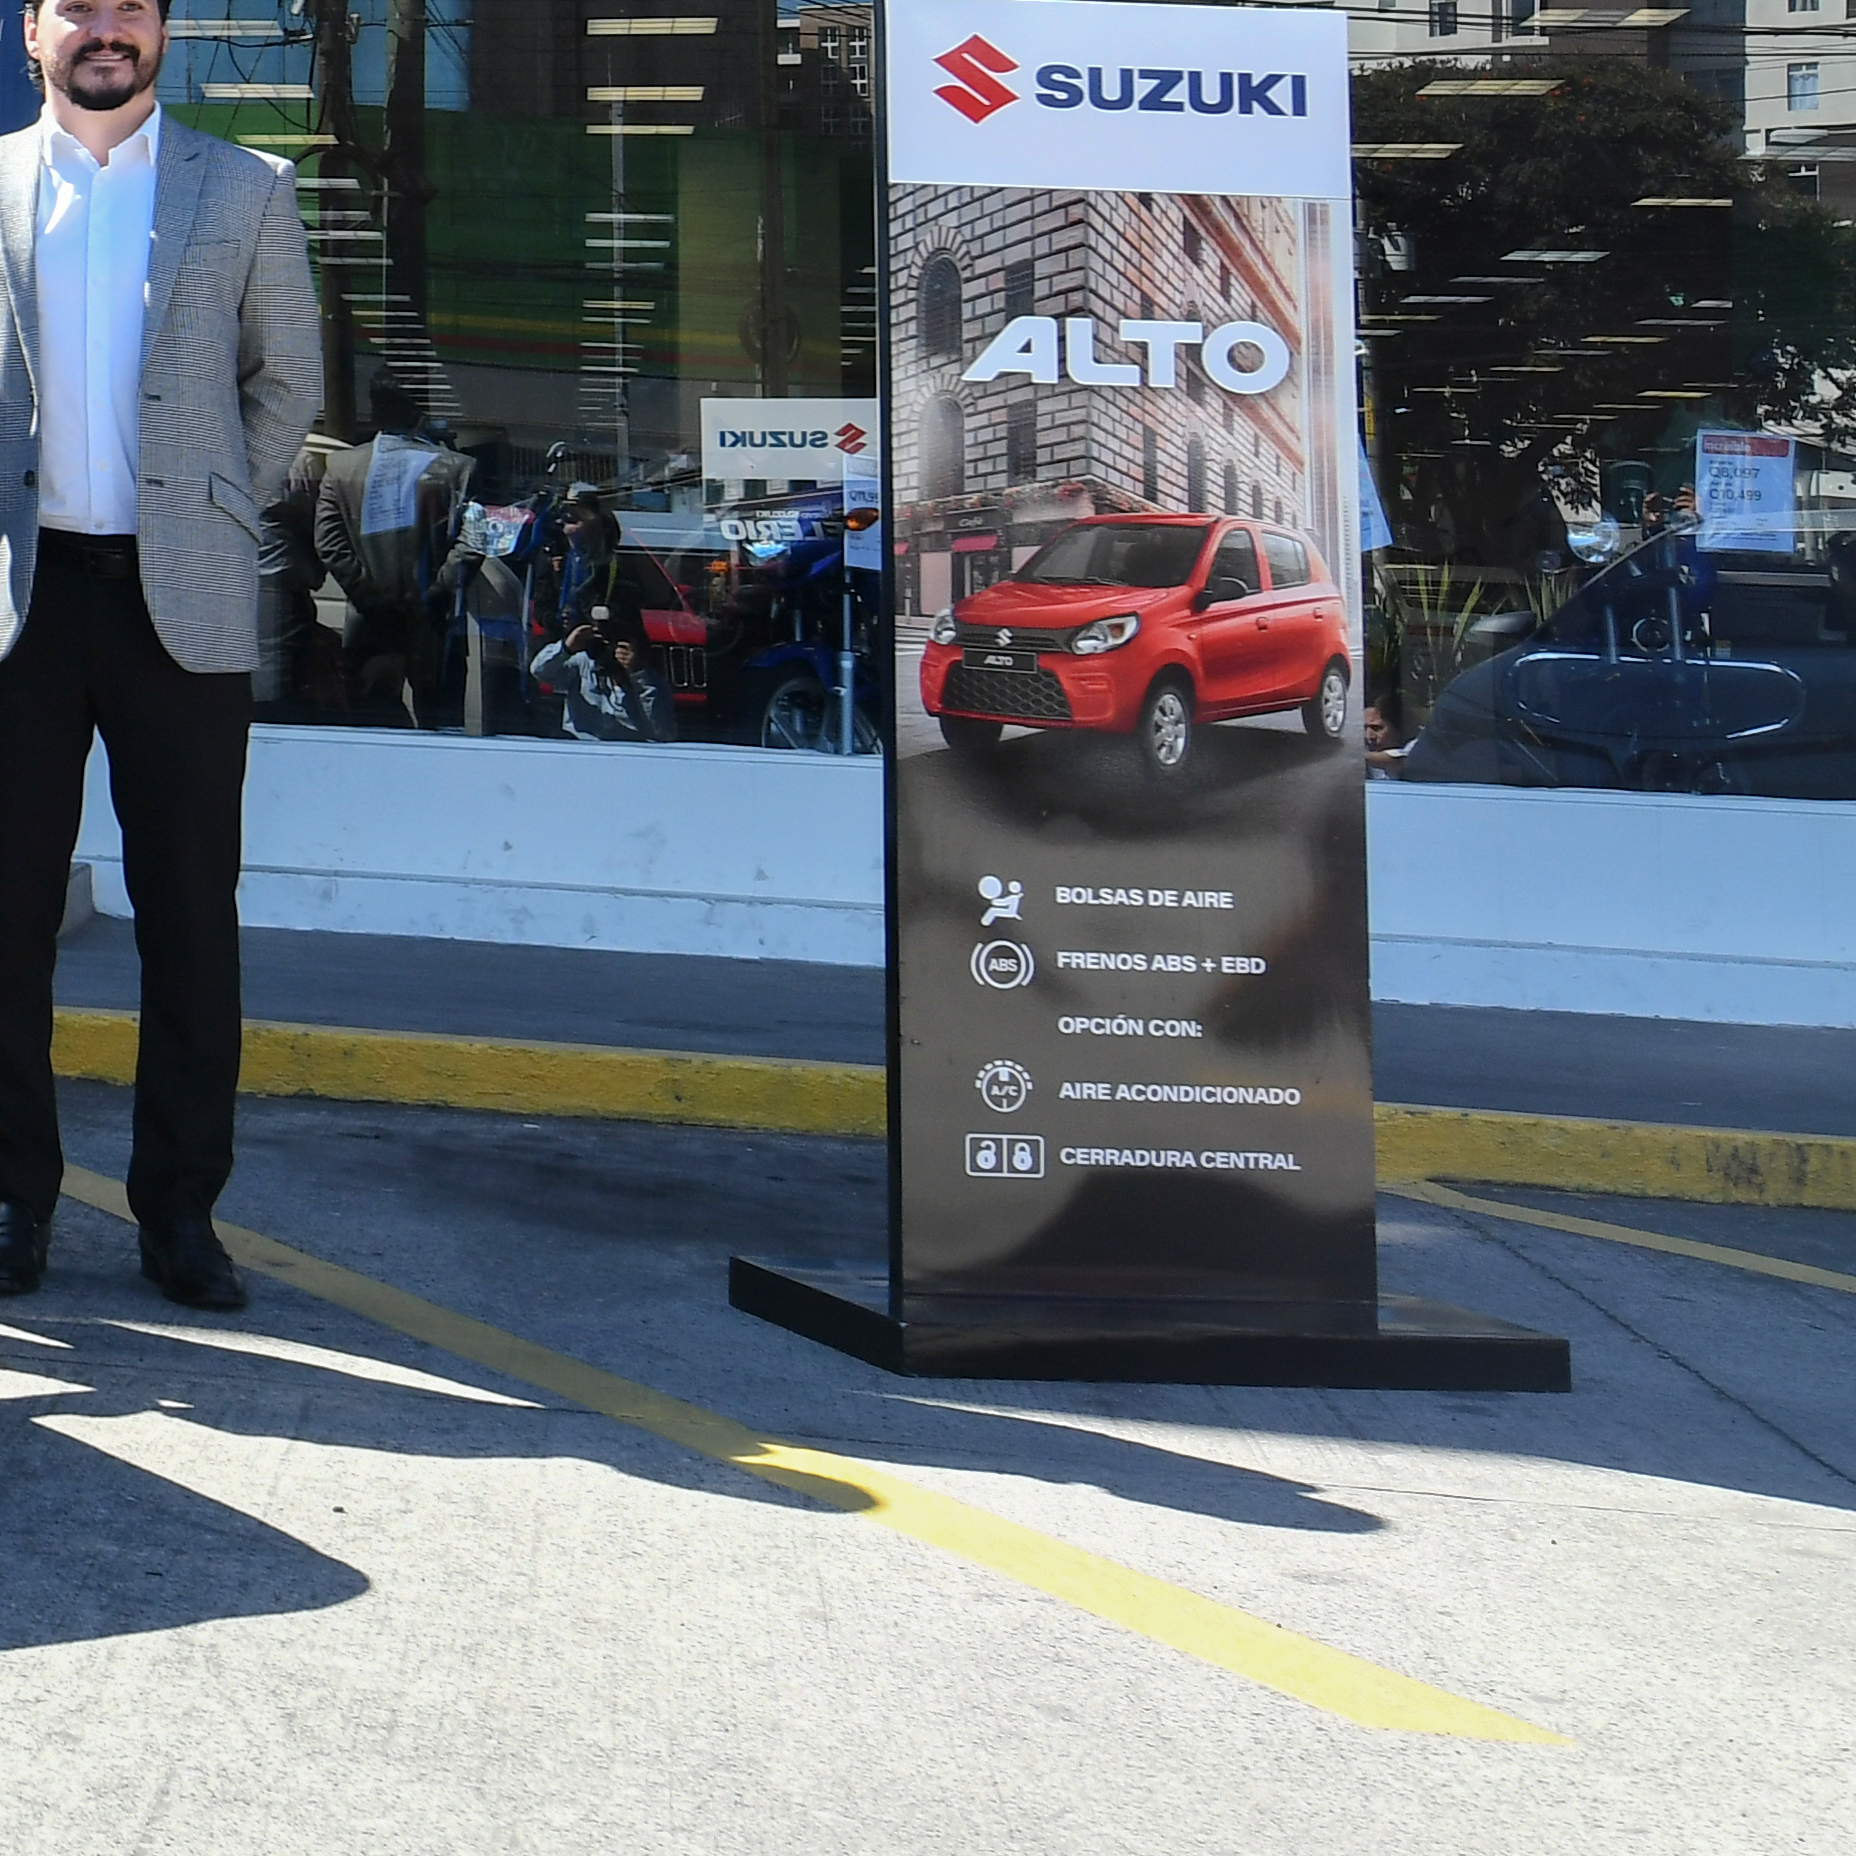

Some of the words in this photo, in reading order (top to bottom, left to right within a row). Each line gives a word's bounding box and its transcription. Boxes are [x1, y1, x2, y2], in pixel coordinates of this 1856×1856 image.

[1034, 62, 1308, 118] SUZUKI
[961, 316, 1290, 395] ALTO
[1055, 886, 1144, 907] BOLSAS
[1148, 890, 1179, 908] DE
[1181, 891, 1234, 909] AIRE
[989, 958, 1018, 972] ABS
[1056, 951, 1148, 971] FRENOS
[1151, 953, 1197, 973] ABS
[1220, 956, 1267, 975] EBD
[1057, 1014, 1144, 1036] OPCIÓN
[1148, 1018, 1203, 1037] CON:
[991, 1084, 1019, 1096] A/C
[1058, 1082, 1111, 1100] AIRE
[1115, 1083, 1301, 1106] ACONDICIONADO
[1059, 1147, 1197, 1168] CERRADURA
[1200, 1151, 1302, 1171] CENTRAL
